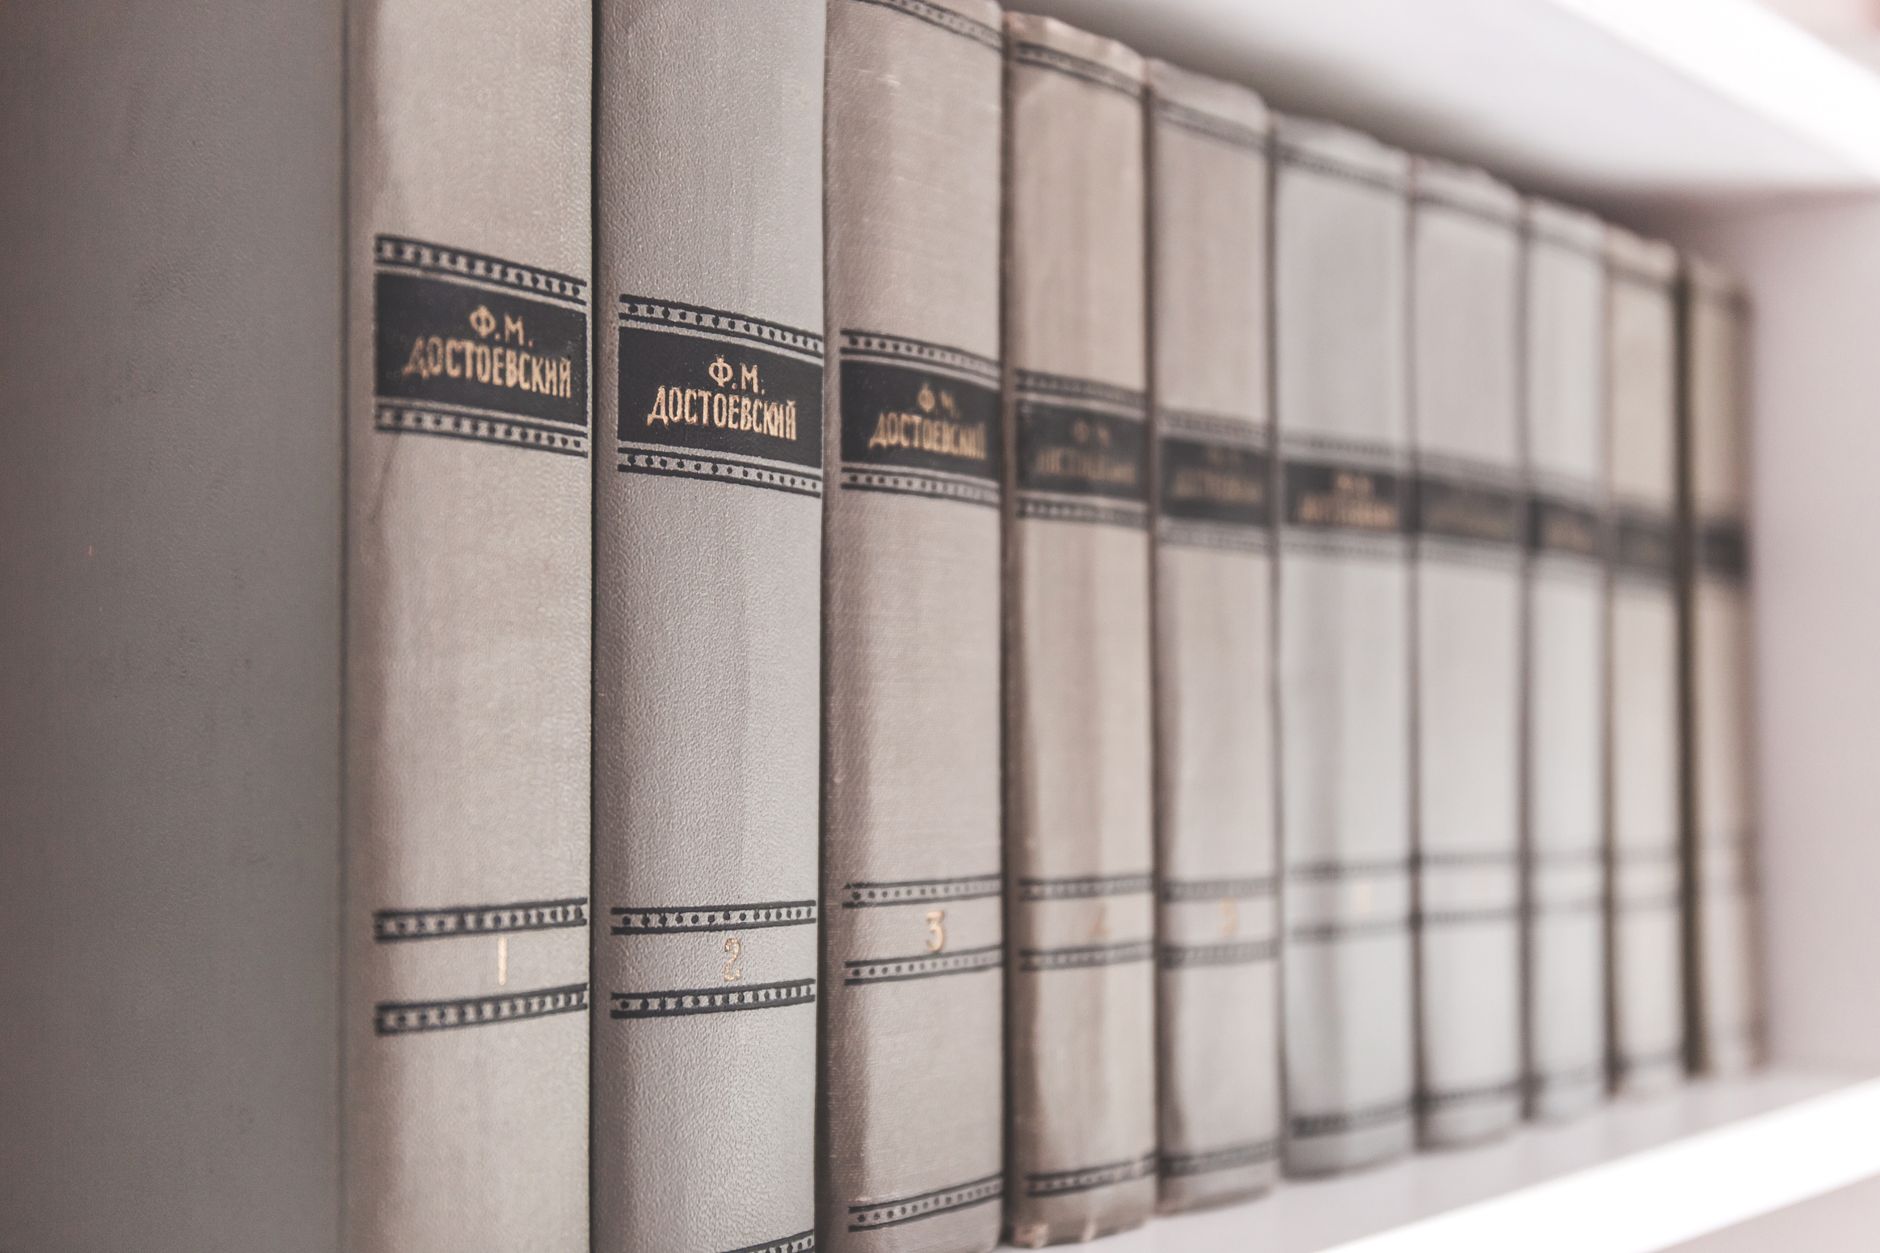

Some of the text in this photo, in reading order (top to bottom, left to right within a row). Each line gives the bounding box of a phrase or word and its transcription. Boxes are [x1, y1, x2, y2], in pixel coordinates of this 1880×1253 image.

[402, 336, 572, 399] ДОСТОЕВСКИЙ
[646, 385, 797, 441] ДОСТОЕВСКИЙ
[926, 910, 945, 953] 3
[498, 936, 507, 986] 1
[724, 938, 743, 982] 2
